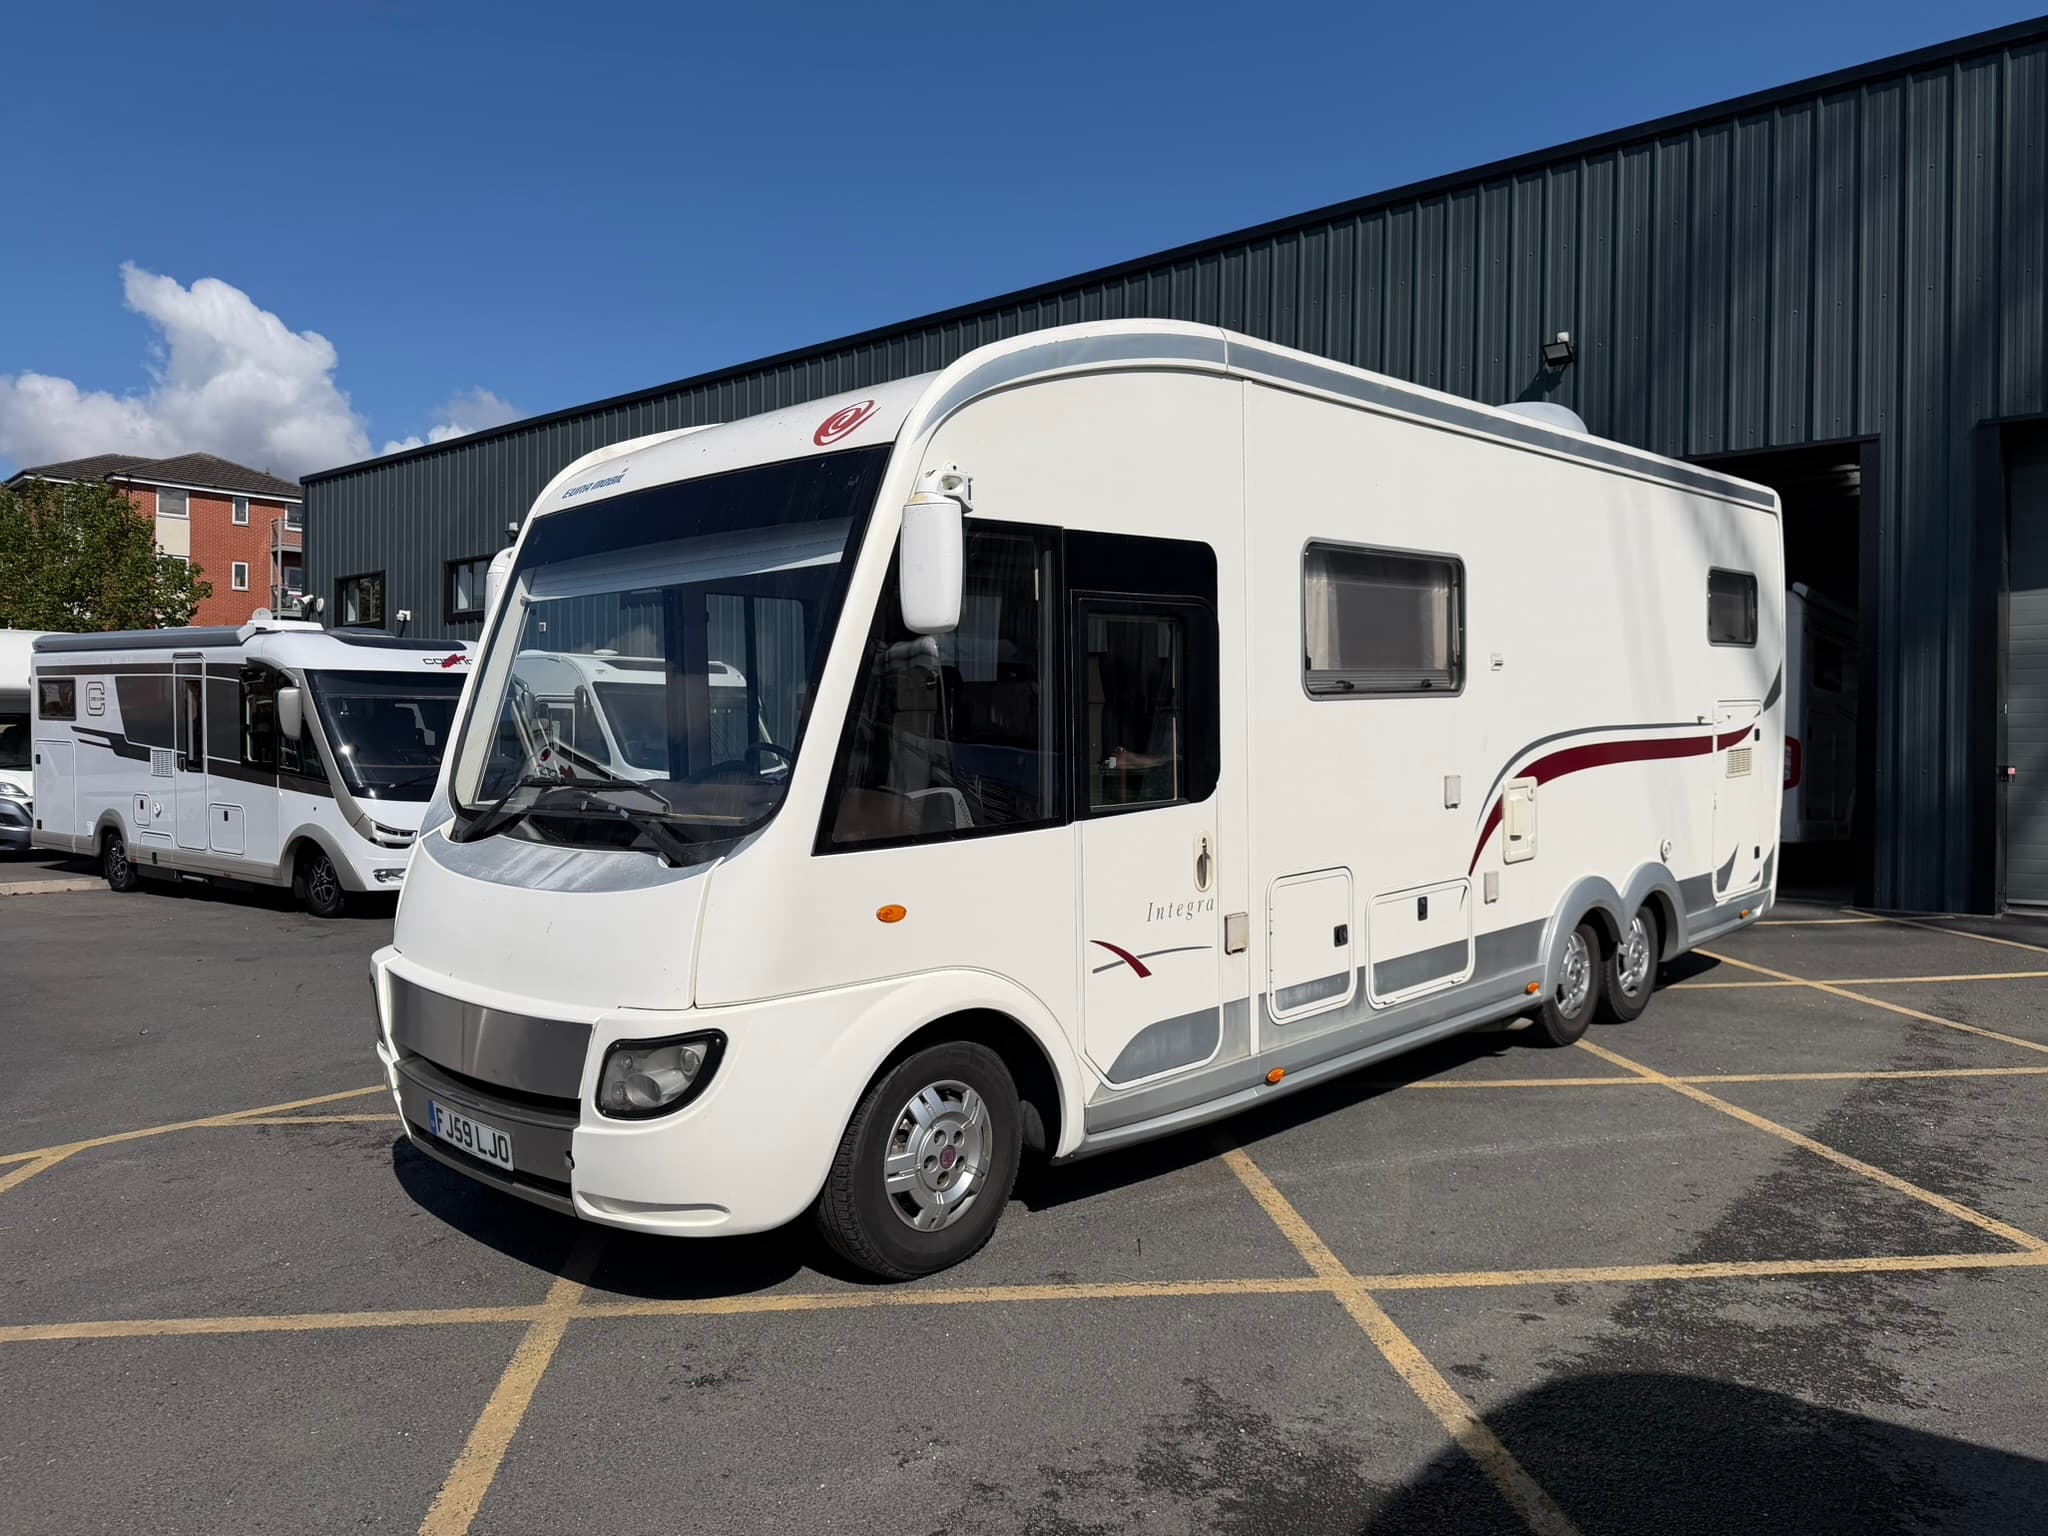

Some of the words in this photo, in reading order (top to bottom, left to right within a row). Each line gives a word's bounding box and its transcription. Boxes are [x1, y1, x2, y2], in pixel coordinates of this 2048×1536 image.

[1147, 898, 1214, 921] Integra
[436, 1107, 472, 1148] FJ59
[475, 1126, 509, 1163] LJO
